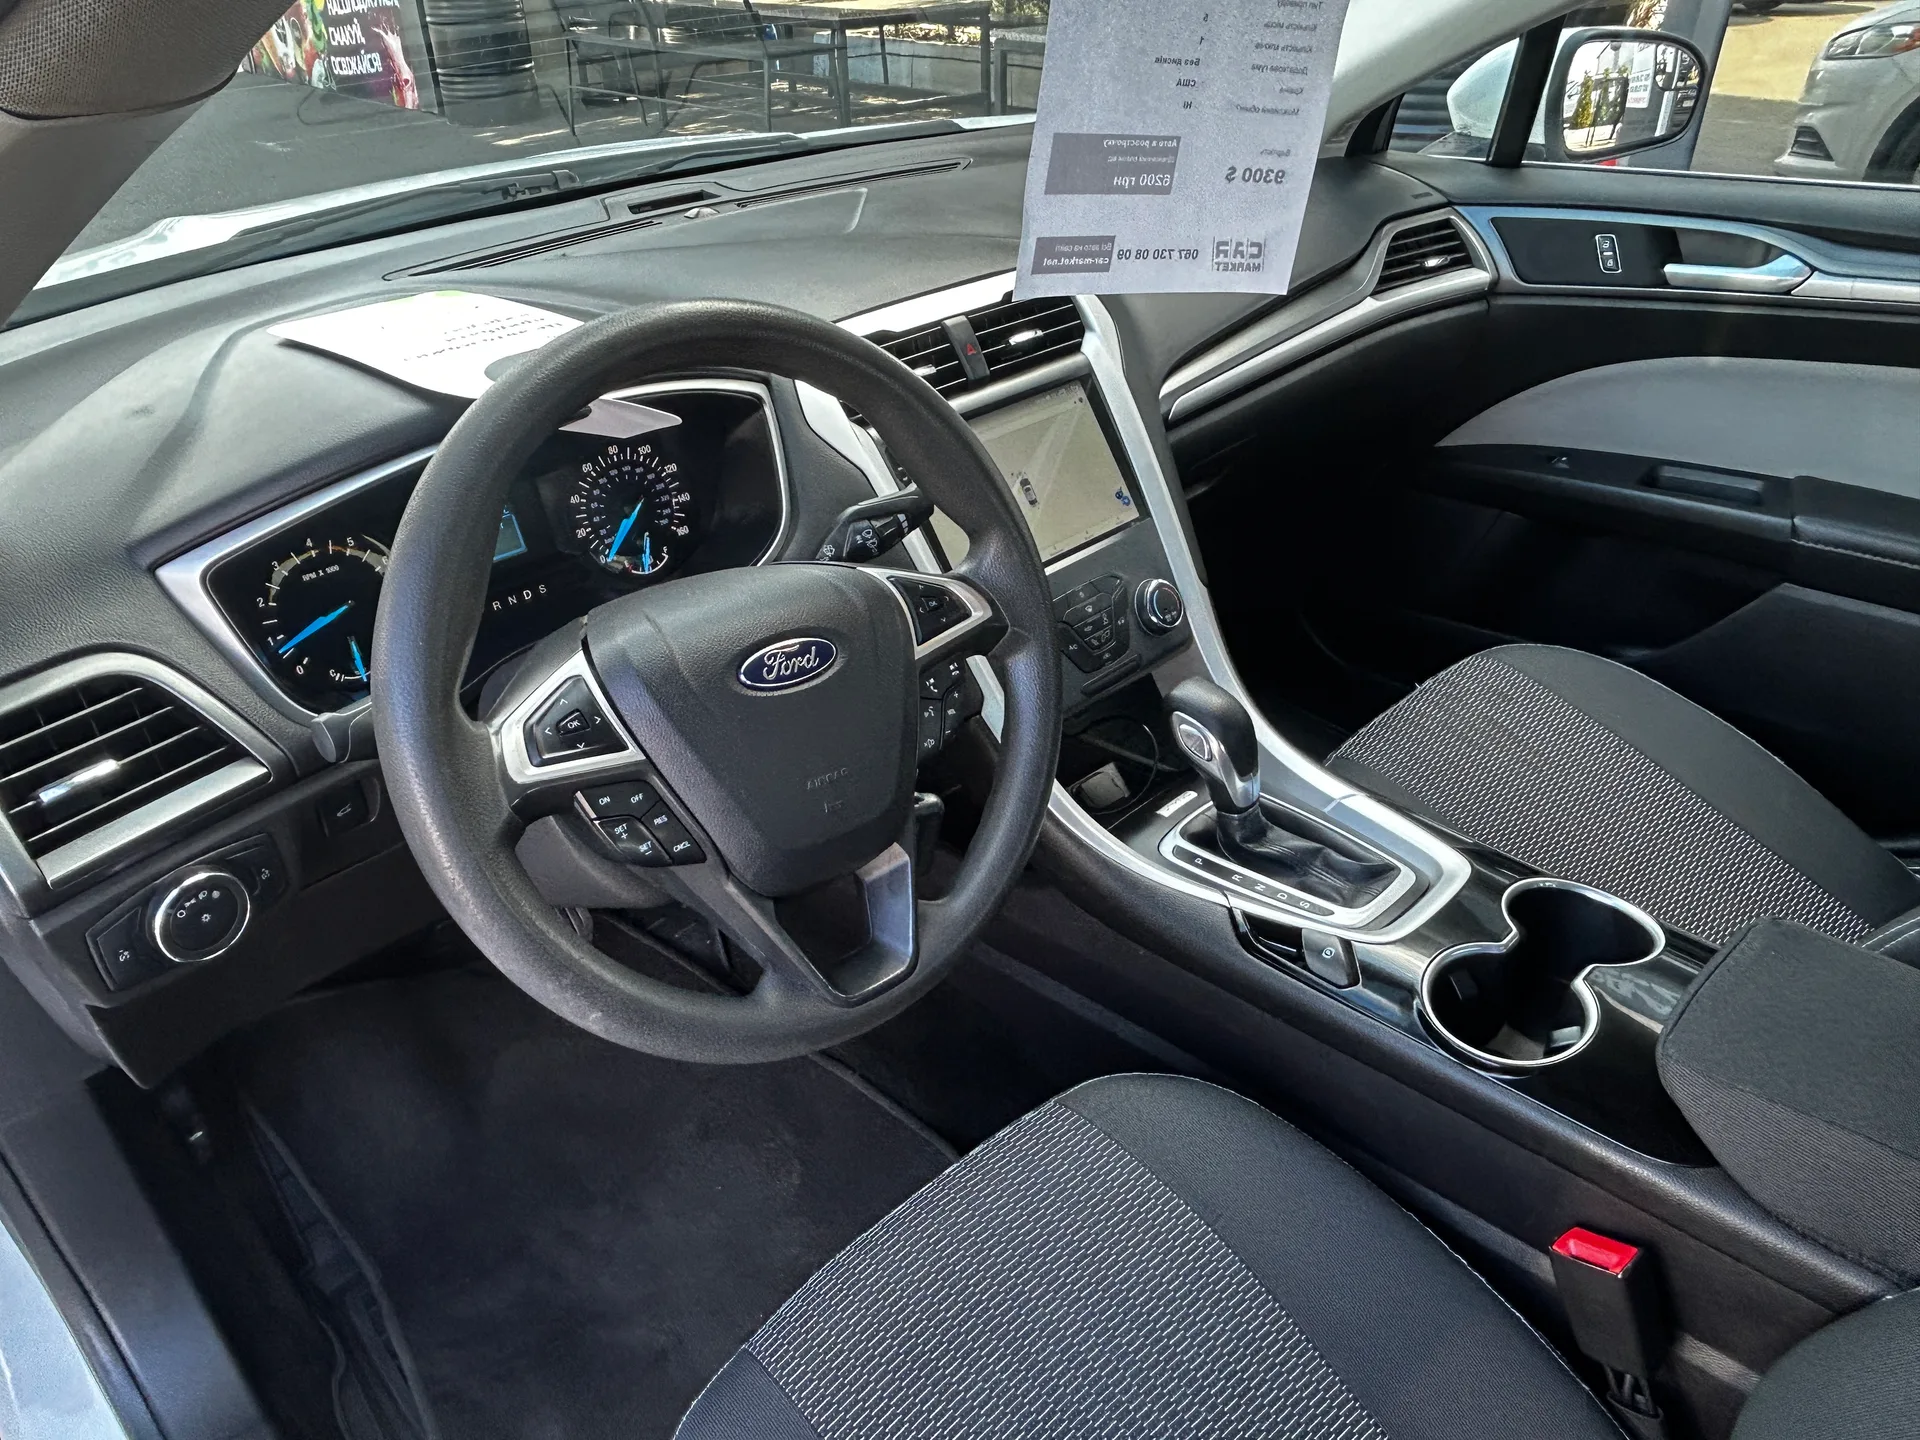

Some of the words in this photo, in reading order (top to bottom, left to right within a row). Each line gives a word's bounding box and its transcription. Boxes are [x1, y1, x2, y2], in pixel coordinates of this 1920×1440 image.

[608, 445, 618, 455] 80
[638, 444, 652, 455] 100
[582, 462, 593, 473] 60
[664, 462, 678, 474] 120
[570, 494, 580, 504] 40
[677, 492, 690, 503] 140
[576, 528, 587, 538] 20
[675, 525, 689, 536] 160
[306, 538, 313, 548] 4
[346, 537, 355, 547] 5
[271, 560, 280, 571] 3
[302, 572, 317, 581] RPM
[256, 597, 265, 608] 2
[492, 601, 502, 611] R
[508, 594, 518, 605] N
[523, 589, 532, 600] D
[538, 584, 547, 593] S
[267, 637, 274, 646] 1
[762, 644, 820, 681] Ford
[295, 665, 304, 675] 0
[567, 718, 581, 729] OK
[599, 795, 611, 805] ON
[630, 792, 644, 804] OFF
[653, 814, 668, 826] RES
[614, 823, 628, 835] SET
[639, 840, 652, 853] SET
[1231, 874, 1243, 882] R
[1254, 883, 1266, 891] N
[1277, 892, 1288, 900] D
[1300, 901, 1310, 909] S
